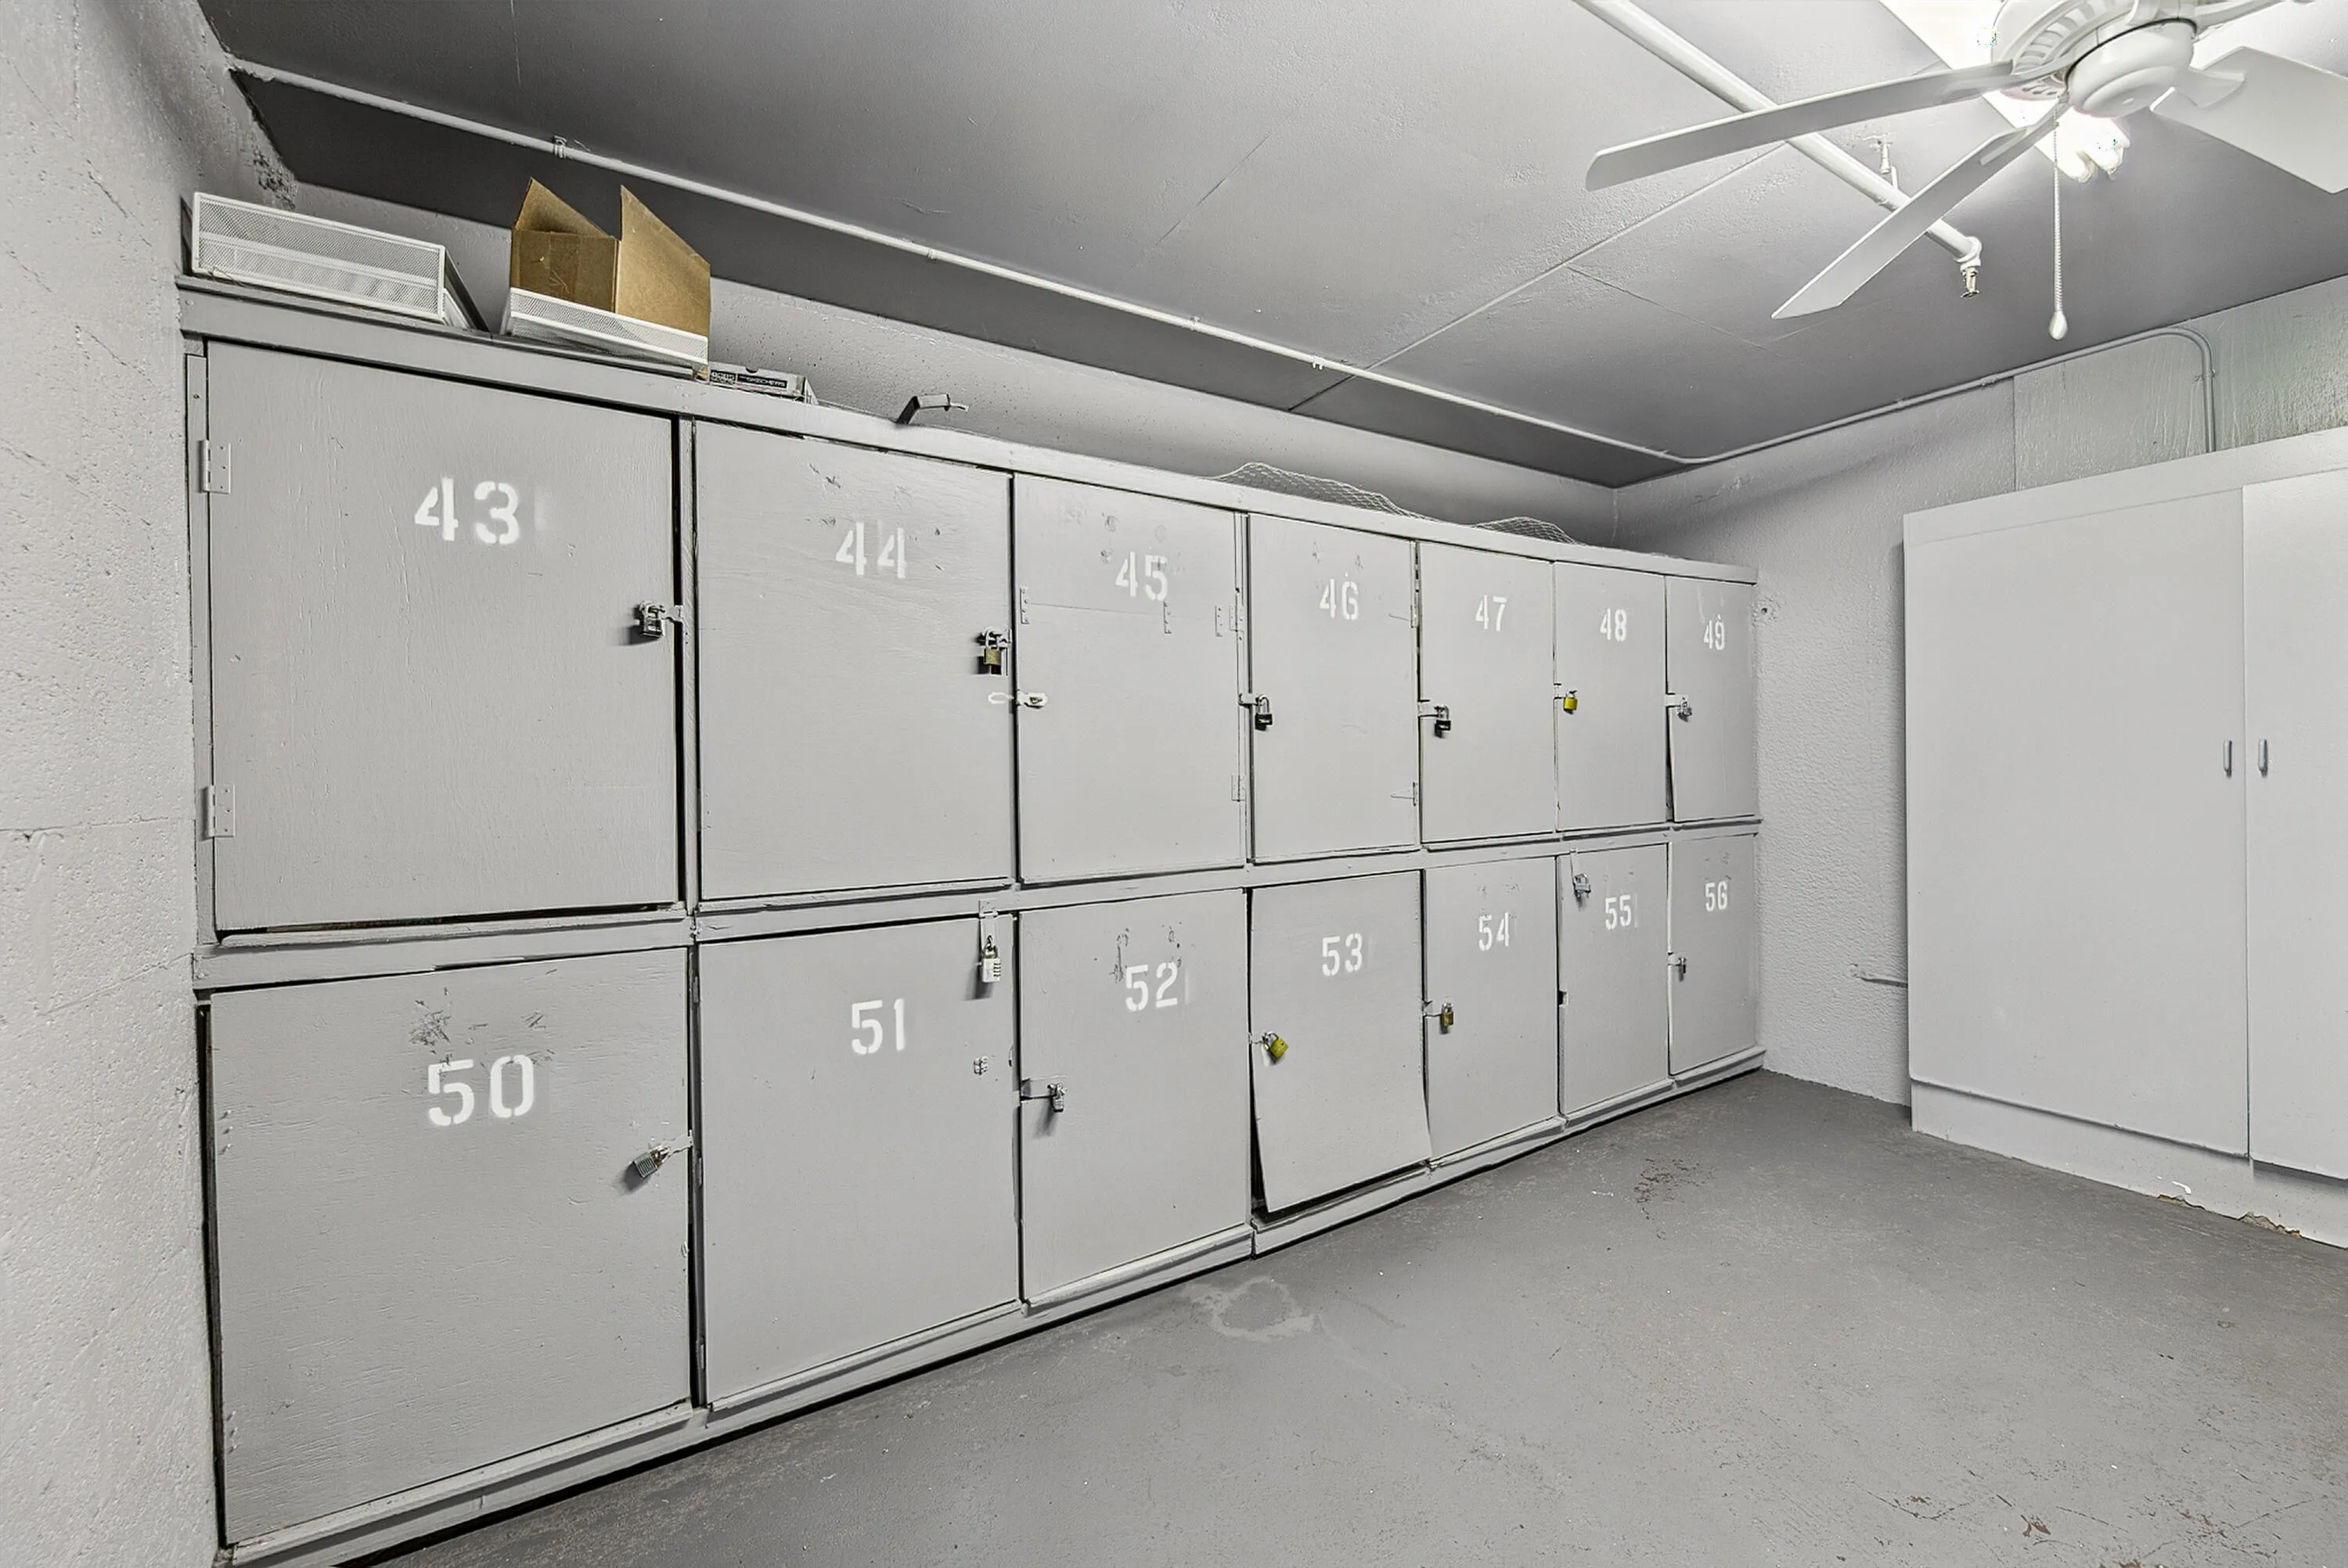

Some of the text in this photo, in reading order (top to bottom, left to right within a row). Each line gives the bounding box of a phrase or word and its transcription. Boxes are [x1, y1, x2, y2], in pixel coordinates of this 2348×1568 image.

[414, 477, 520, 545] 43
[835, 522, 907, 579] 44
[1115, 551, 1168, 602] 45
[1320, 578, 1359, 620] 46
[1475, 594, 1507, 631] 47
[1600, 608, 1627, 642] 48
[1703, 619, 1725, 650] 49
[1605, 894, 1632, 930] 55
[1705, 880, 1727, 912] 56
[1478, 912, 1510, 951] 54
[1322, 933, 1363, 976] 53
[1125, 962, 1178, 1012] 52
[852, 998, 905, 1056] 51
[427, 1054, 535, 1127] 50
